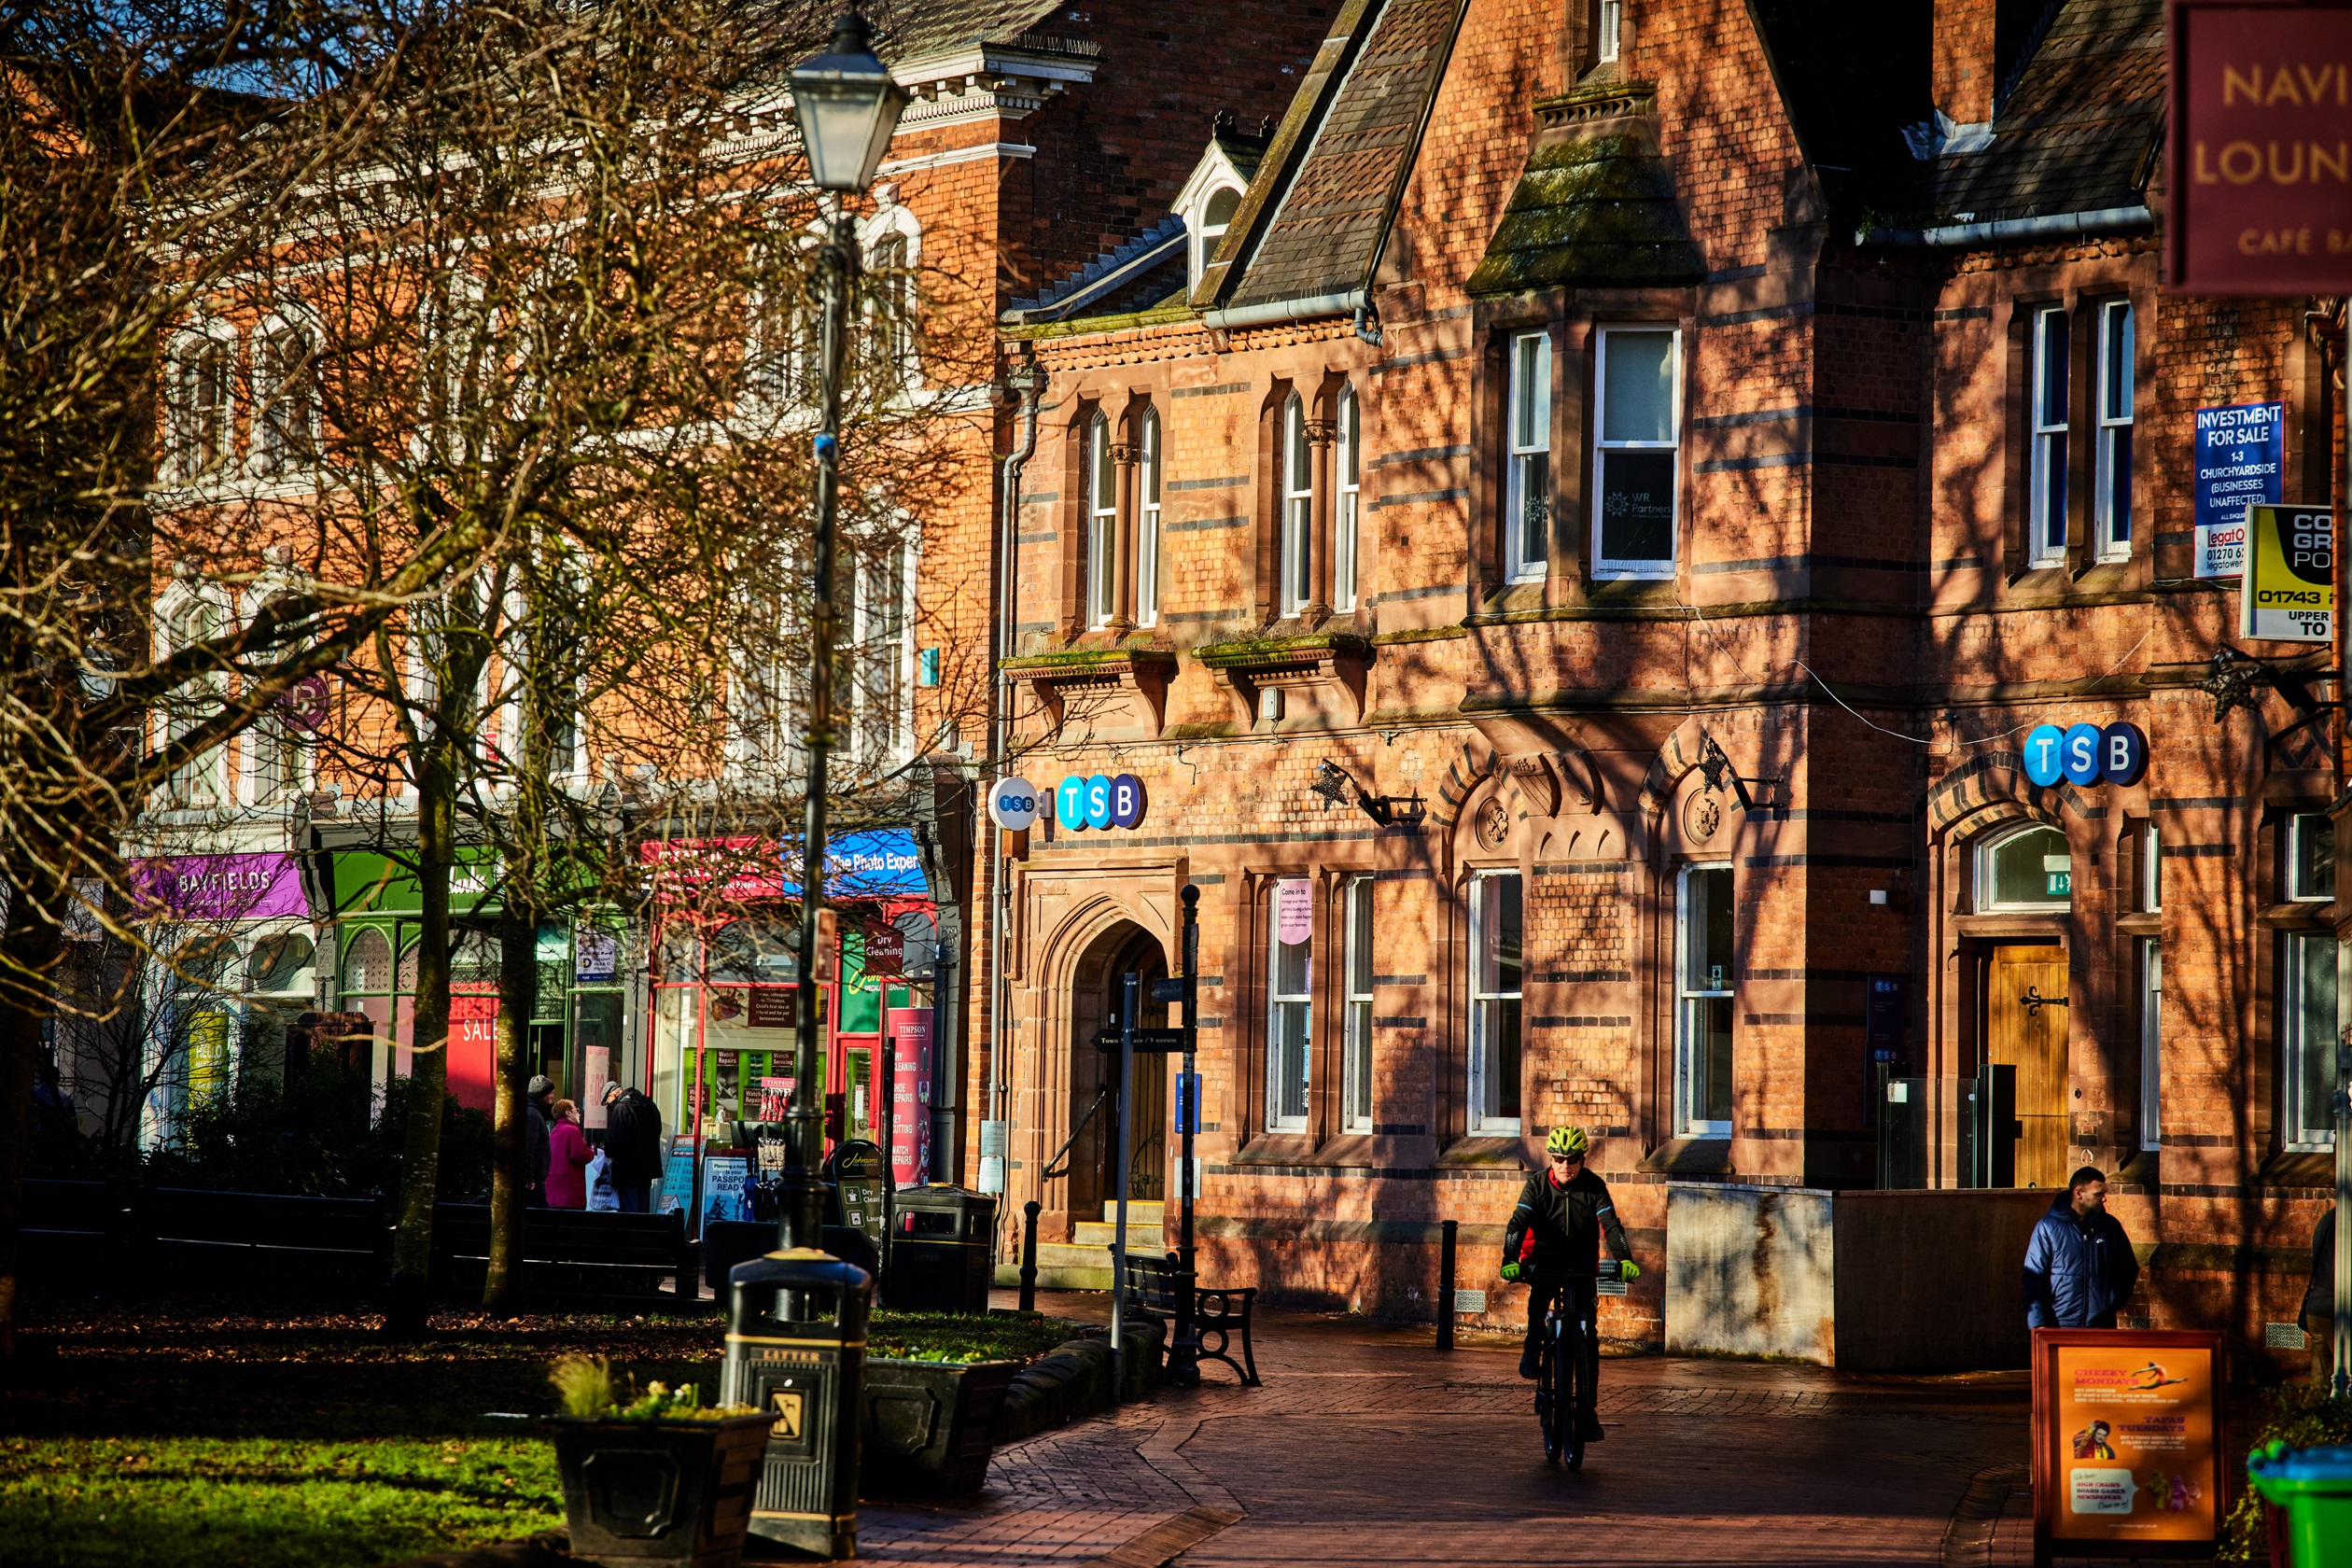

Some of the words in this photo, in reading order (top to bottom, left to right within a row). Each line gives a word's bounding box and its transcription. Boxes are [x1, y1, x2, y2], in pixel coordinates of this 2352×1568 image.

[2197, 405, 2281, 429] INVESTMENT
[2207, 429, 2234, 447] FOR
[2236, 427, 2269, 444] SALE
[2231, 451, 2245, 462] 1-3
[2200, 463, 2276, 480] CHURCHYARDSIDE
[2211, 479, 2264, 494] (BUSINESSES
[1631, 492, 1650, 502] WR
[2209, 494, 2266, 509] UNAFFECTED)
[1631, 503, 1672, 513] Partners
[2206, 548, 2233, 561] 01270
[2235, 547, 2244, 559] 6
[2259, 590, 2320, 605] 01743
[2289, 611, 2329, 621] UPPER
[2300, 622, 2326, 637] TO
[2036, 735, 2130, 773] TSB
[1064, 784, 1133, 819] TSB
[831, 854, 851, 871] The
[853, 854, 885, 871] Photo
[887, 853, 920, 874] Exper
[178, 871, 272, 892] BAYFIELDS
[449, 865, 487, 894] larks
[877, 935, 892, 945] Dry
[866, 946, 903, 958] Cleaning
[463, 1018, 497, 1042] SALE
[899, 1026, 926, 1034] TIMPSON
[195, 1043, 223, 1059] HELLO
[894, 1062, 917, 1072] LEANING
[842, 1152, 878, 1168] Johnsons
[915, 1254, 941, 1263] LITTER
[763, 1348, 820, 1363] LITTER
[2074, 1378, 2139, 1386] MONDAYS
[2118, 1424, 2185, 1433] TUESDAYS
